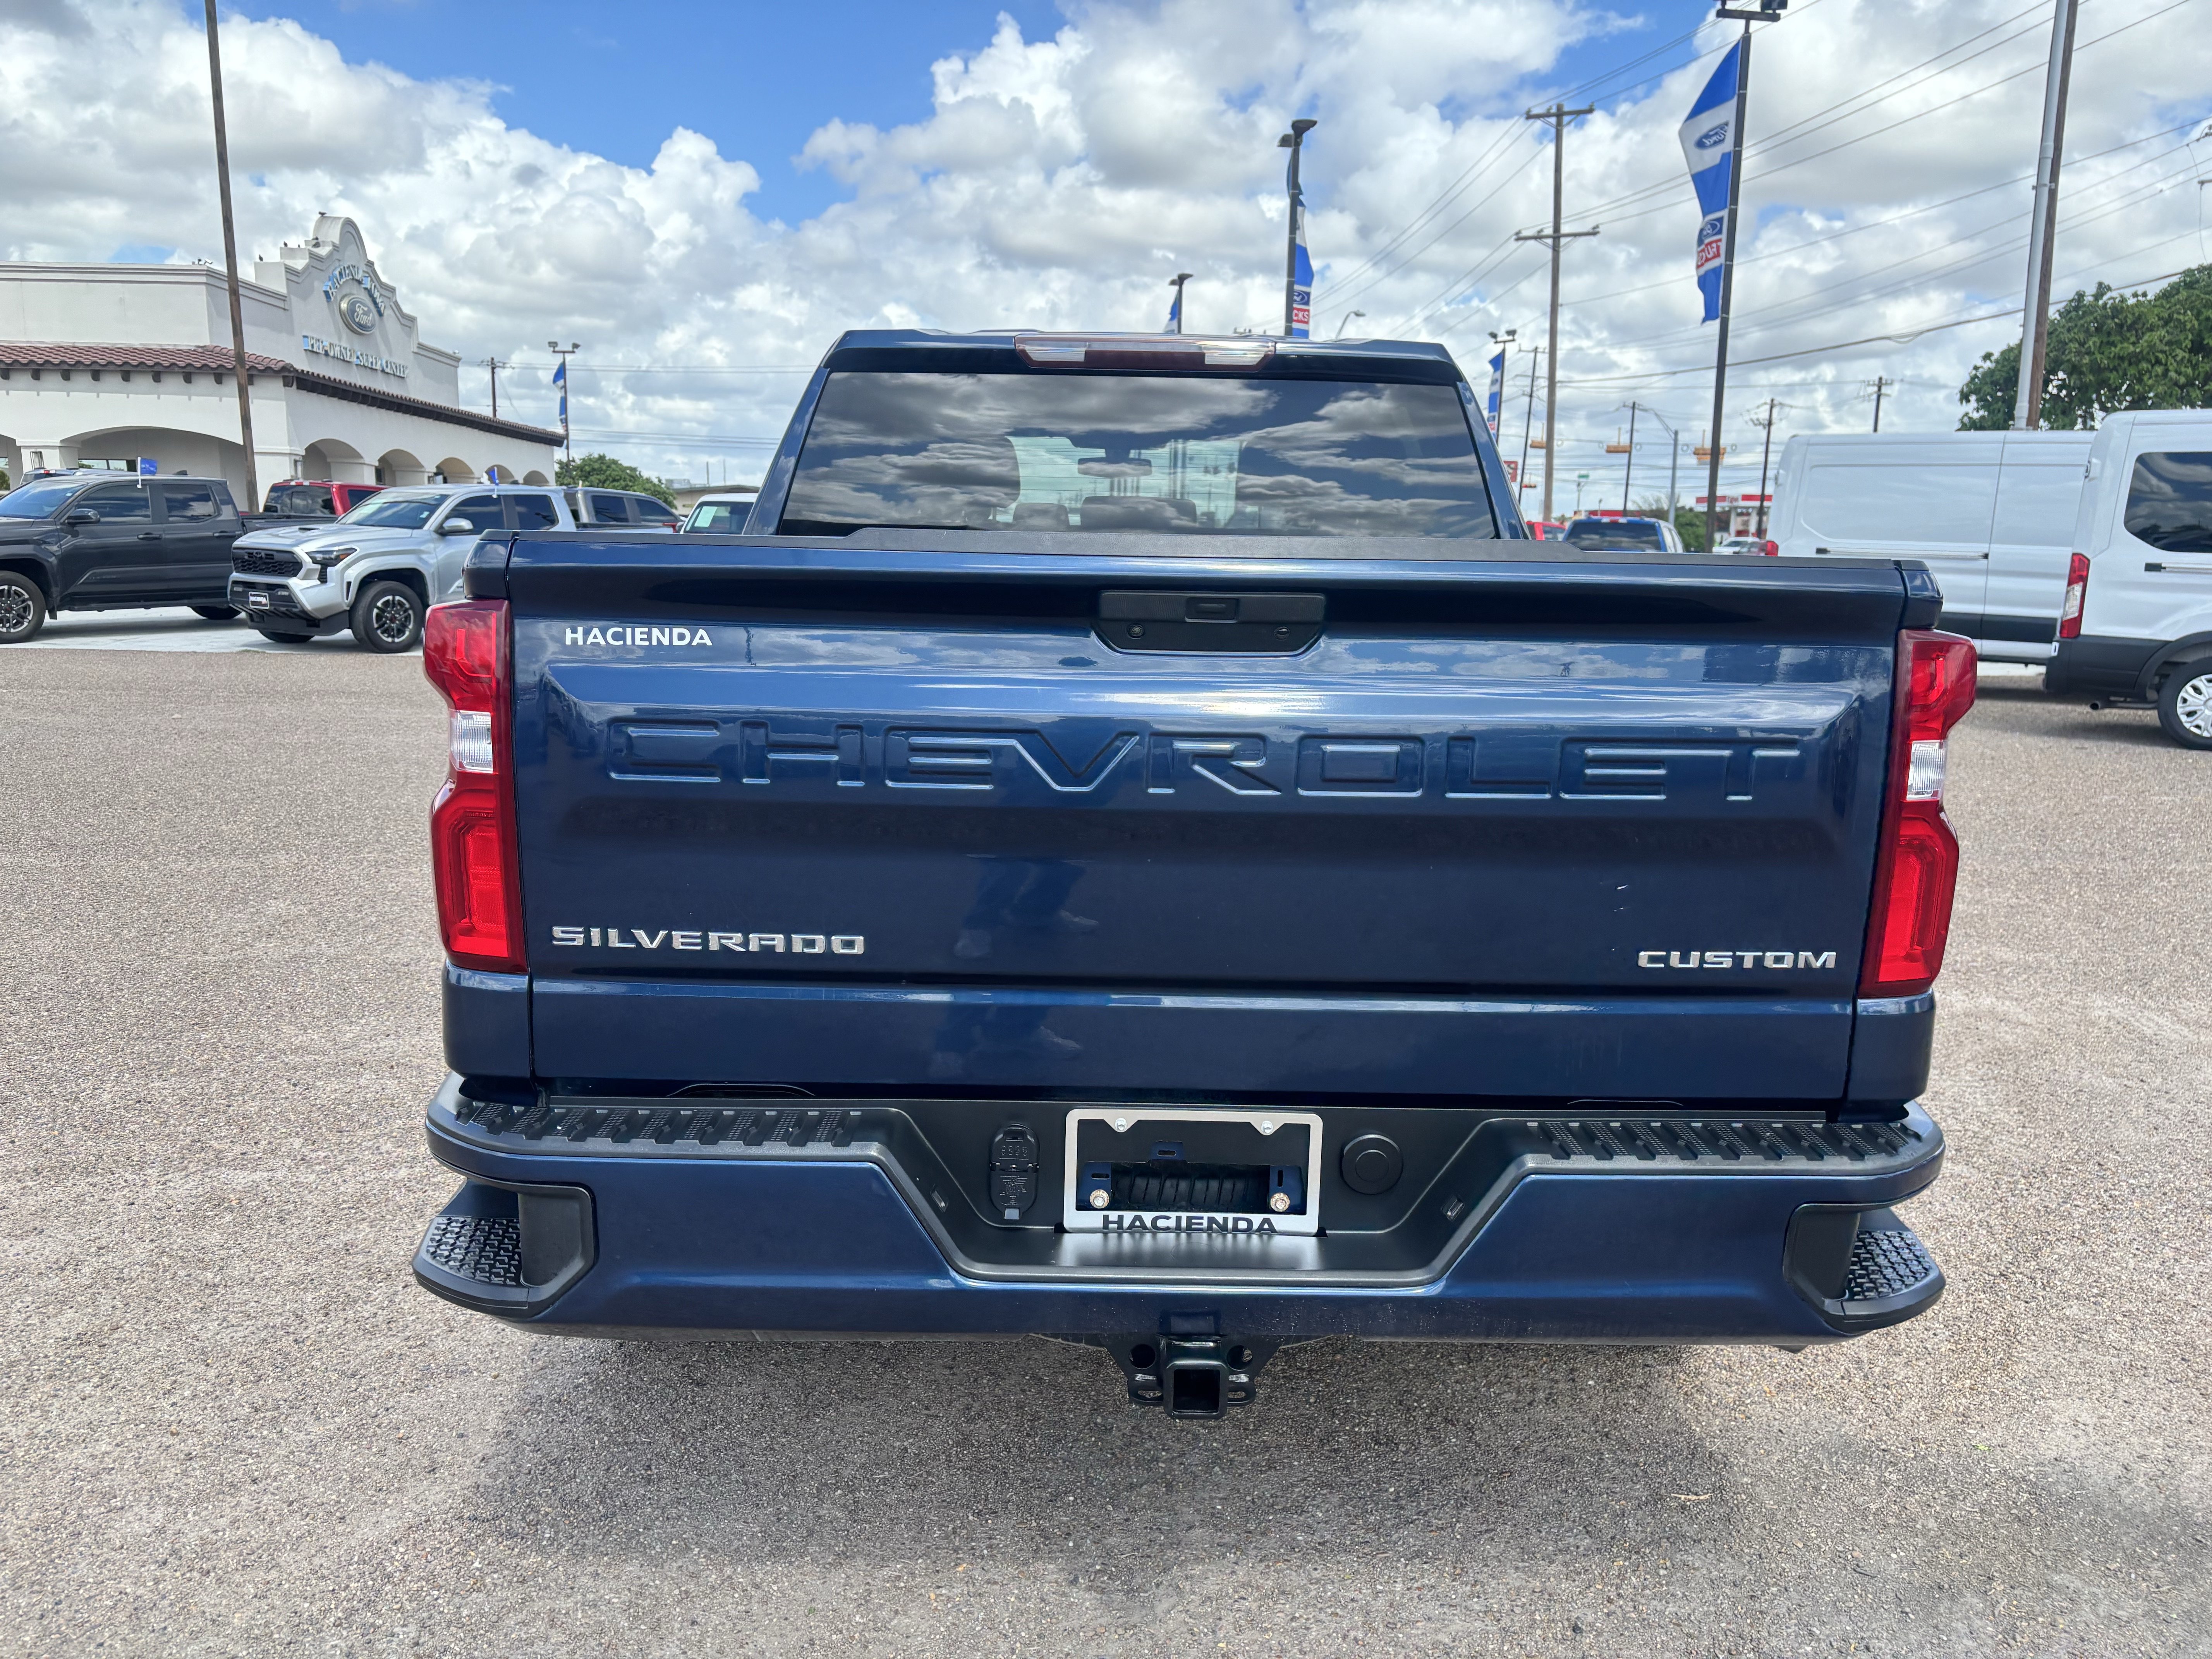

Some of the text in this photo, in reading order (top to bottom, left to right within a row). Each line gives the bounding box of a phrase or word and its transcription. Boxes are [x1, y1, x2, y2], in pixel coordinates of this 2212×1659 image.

[354, 303, 373, 326] Ford
[1292, 309, 1309, 322] CKS
[565, 626, 713, 646] HACIENDA
[607, 717, 1803, 800] CHEVROLET
[551, 926, 865, 954] SILVERADO
[1638, 951, 1837, 969] CUSTOM
[1102, 1214, 1278, 1234] HACIENDA
